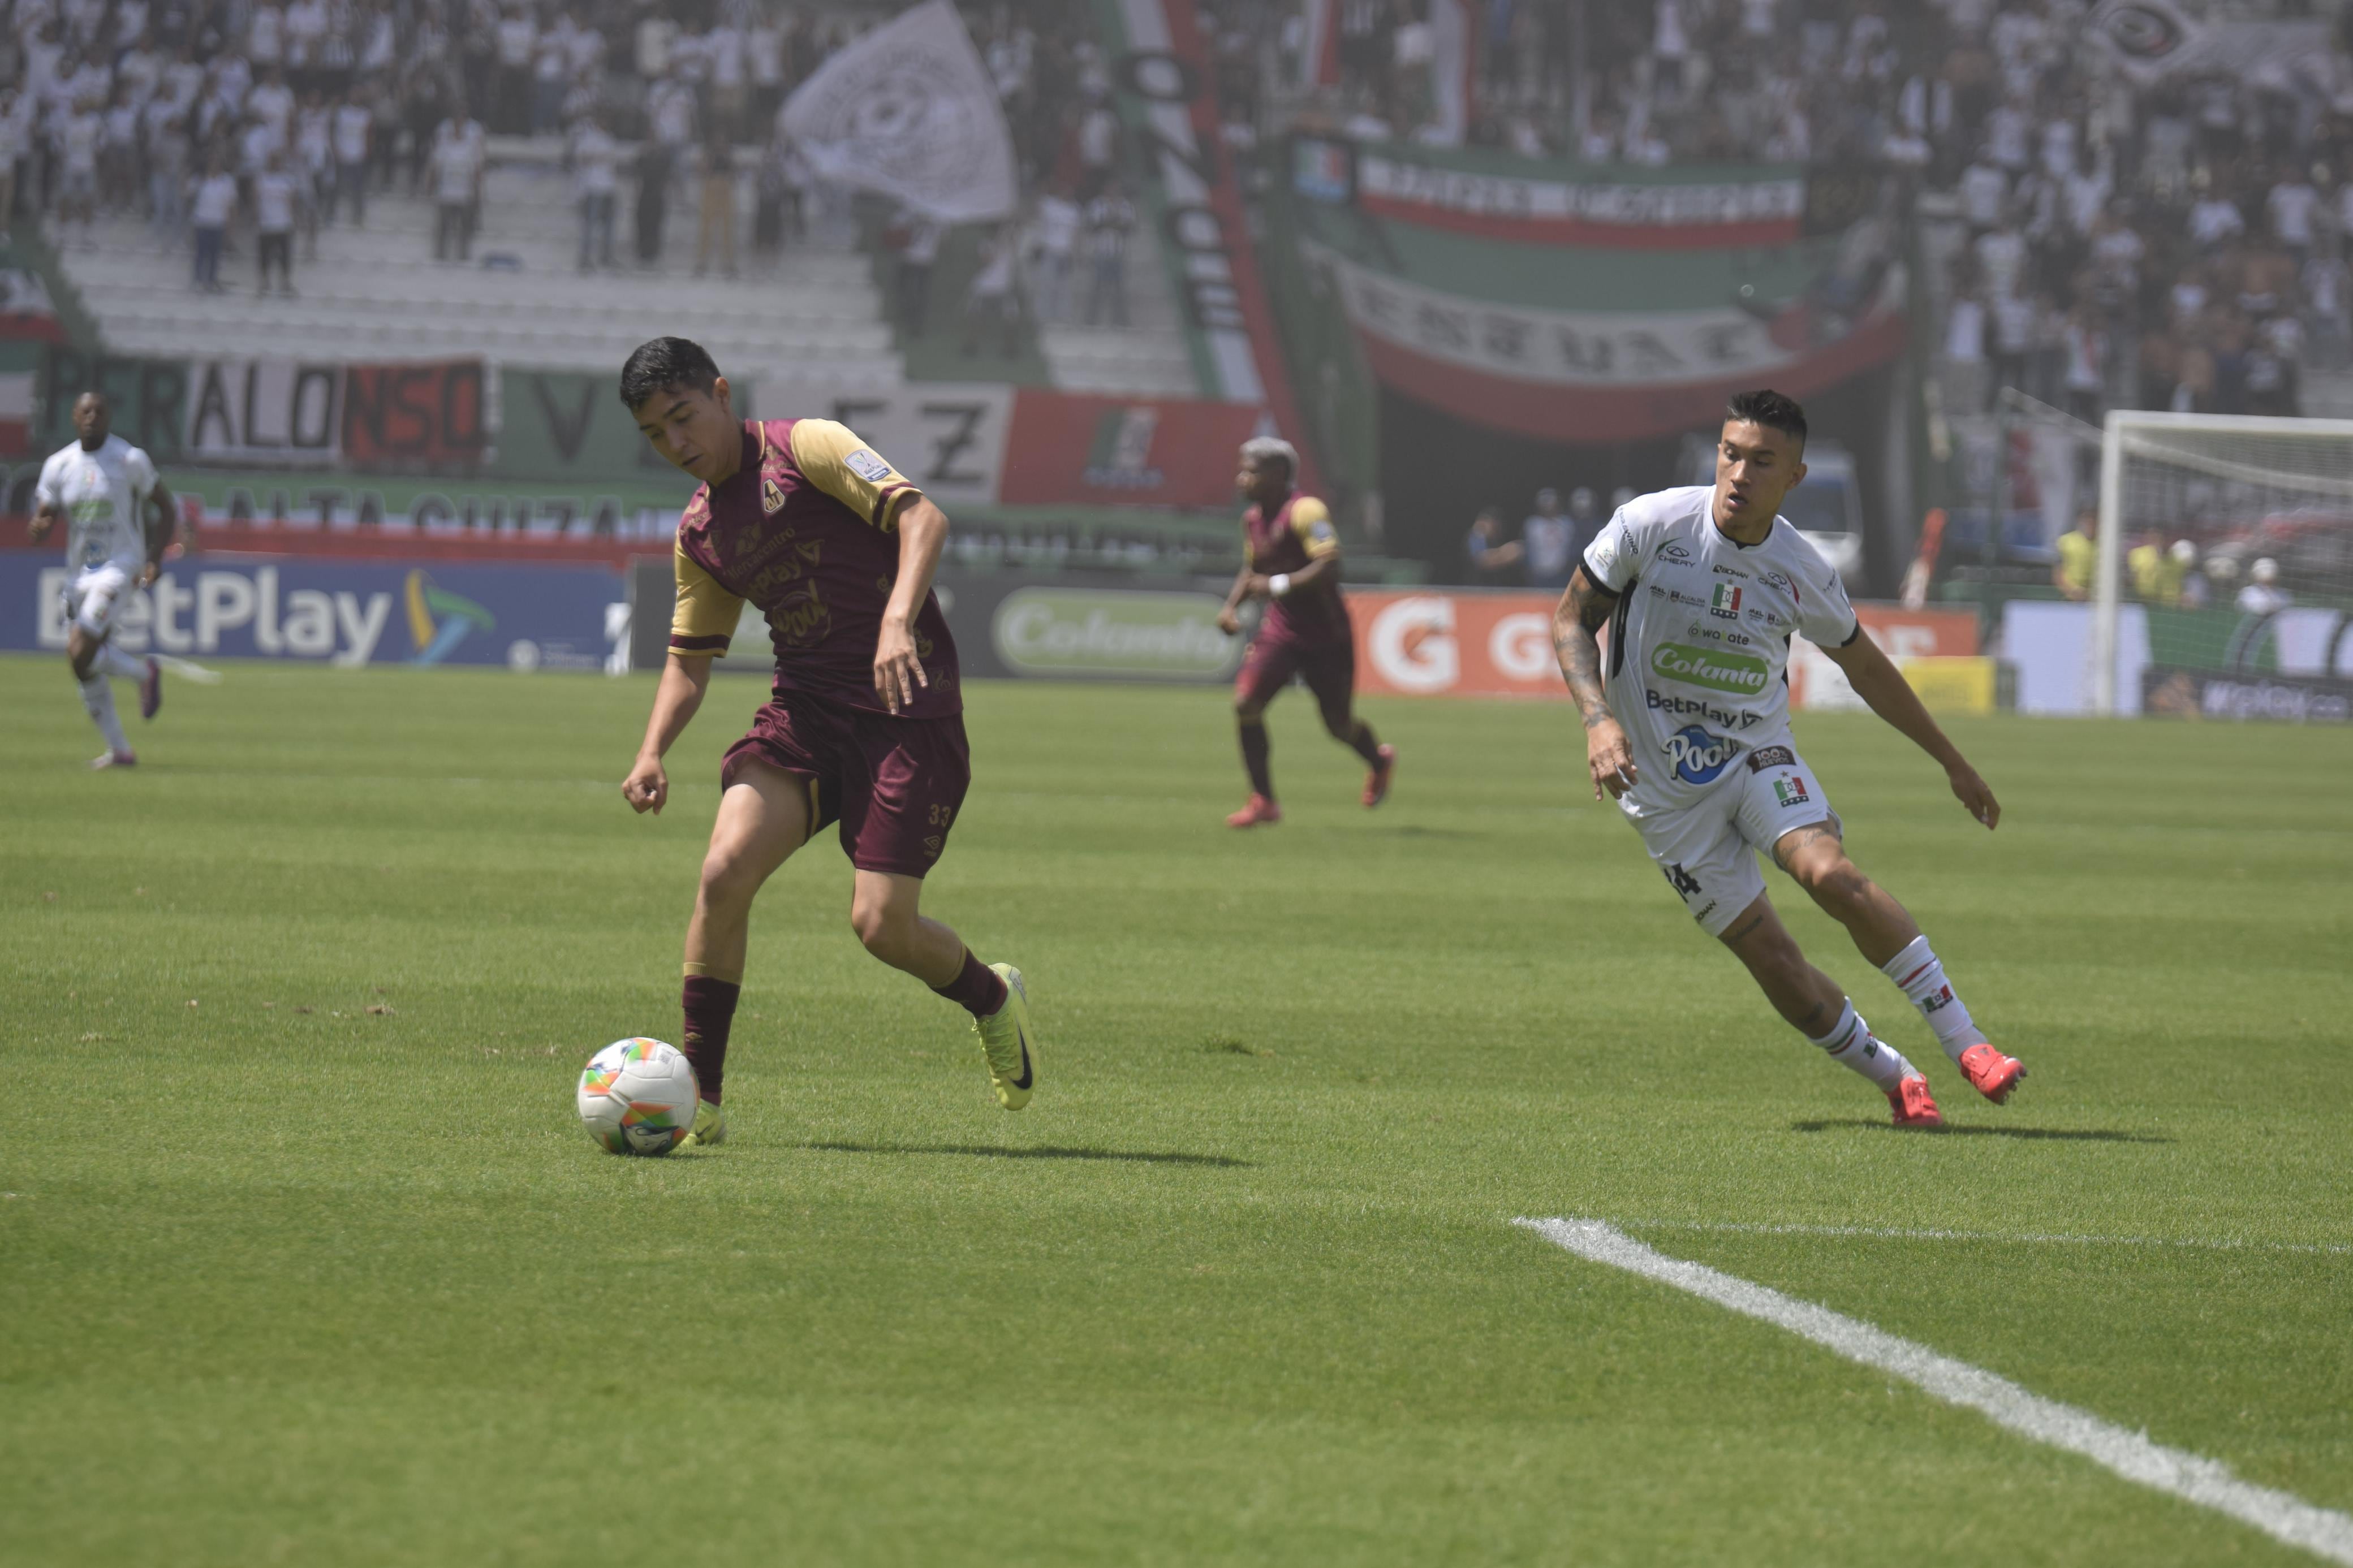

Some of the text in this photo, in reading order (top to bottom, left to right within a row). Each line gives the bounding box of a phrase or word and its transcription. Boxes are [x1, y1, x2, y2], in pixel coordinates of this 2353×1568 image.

[728, 526, 797, 580] Mercacentro
[1658, 554, 1696, 568] CHERY
[1703, 628, 1749, 645] wakate
[1653, 648, 1766, 687] Colanta
[1646, 689, 1738, 729] BetPlay
[1660, 735, 1739, 780] Pool
[928, 804, 952, 827] 33
[1664, 862, 1703, 904] 4
